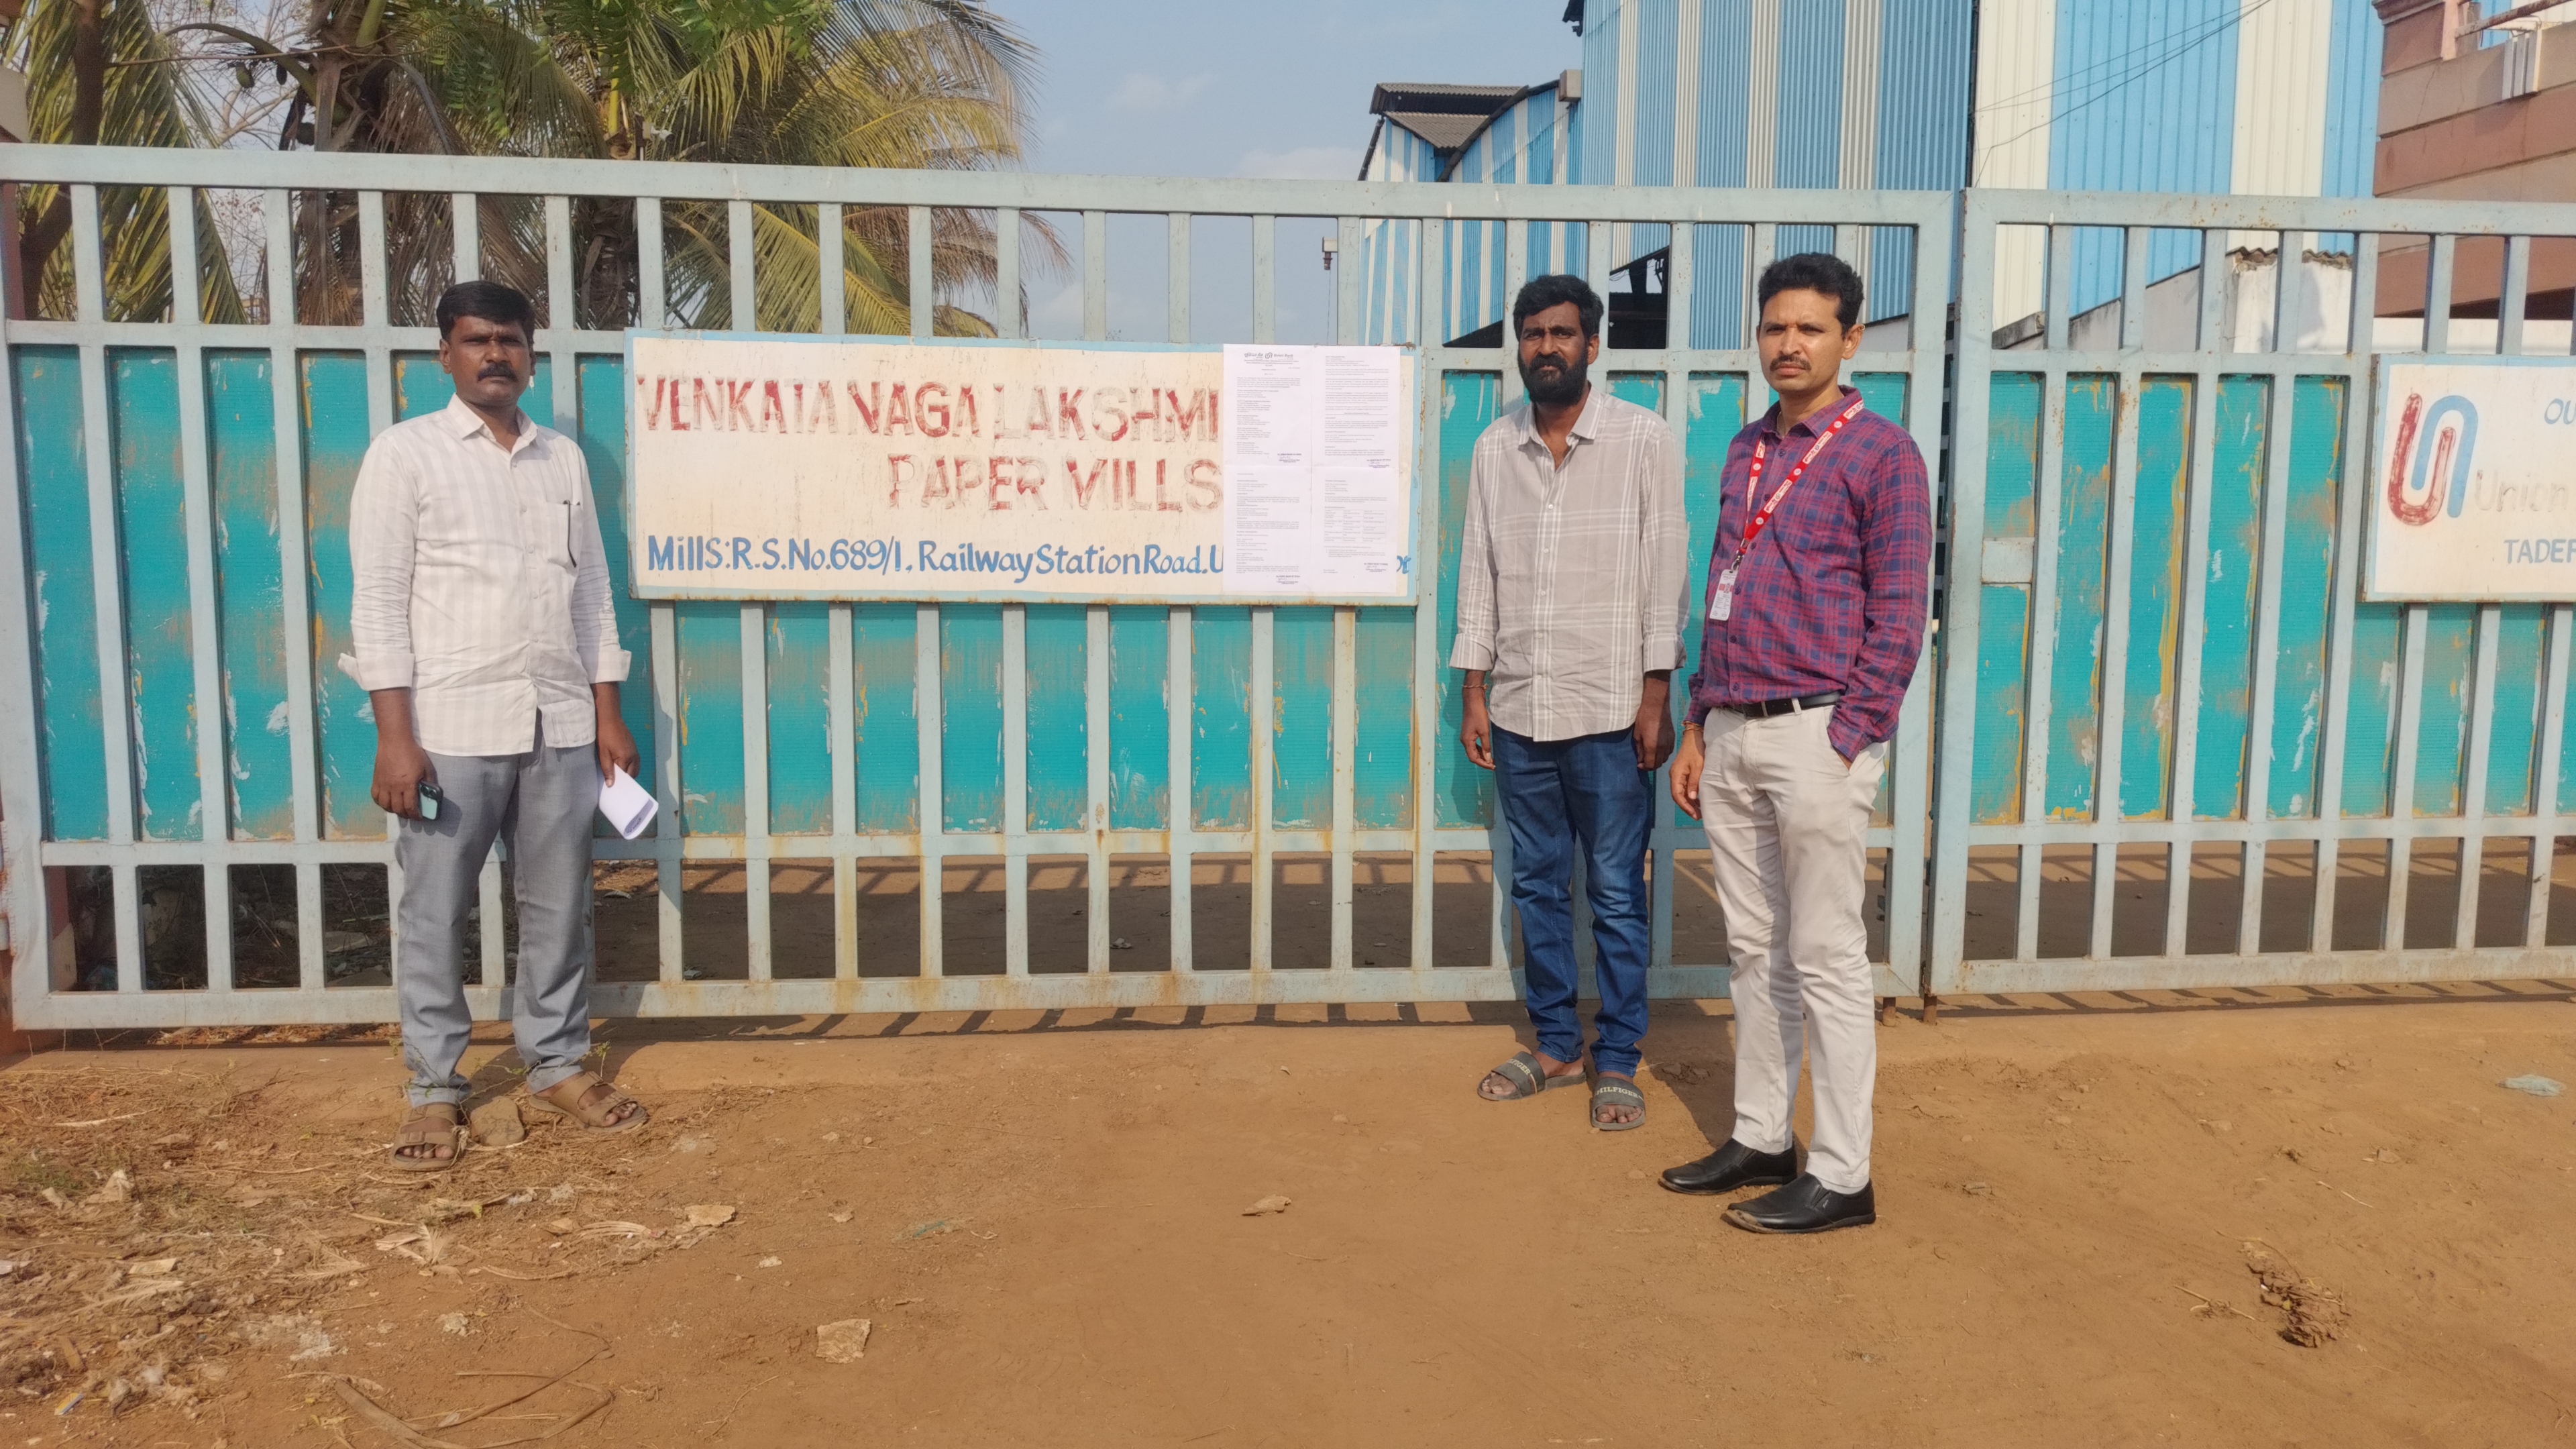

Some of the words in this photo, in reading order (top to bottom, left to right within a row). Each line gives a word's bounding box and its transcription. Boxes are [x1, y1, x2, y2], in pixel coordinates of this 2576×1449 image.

[636, 374, 840, 435] VENKATA
[846, 379, 982, 438] NAGA
[992, 383, 1219, 443] LAKSHMI
[888, 453, 1049, 511] PAPER
[1063, 456, 1224, 513] MILLS
[2474, 470, 2569, 512] Union
